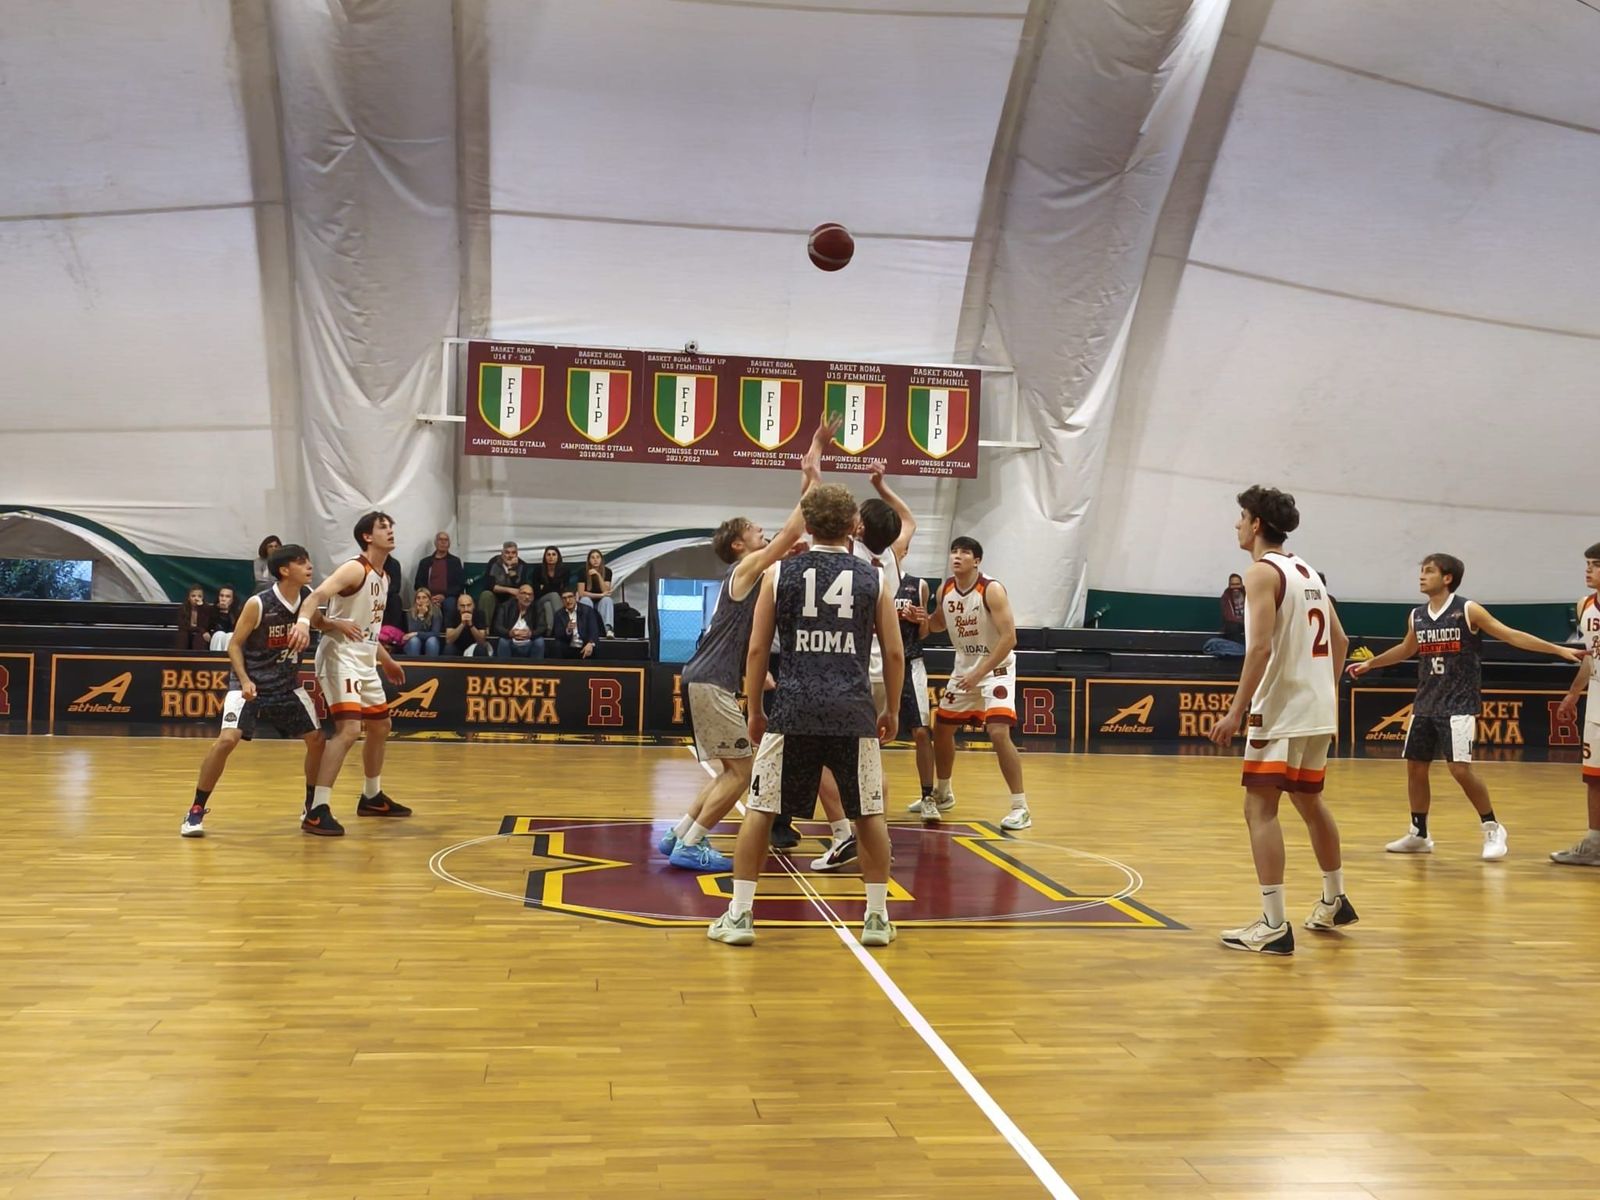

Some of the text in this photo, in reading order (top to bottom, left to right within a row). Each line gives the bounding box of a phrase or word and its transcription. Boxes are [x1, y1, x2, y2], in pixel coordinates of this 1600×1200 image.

[589, 359, 626, 367] FEMMINILE
[676, 363, 712, 372] FEMMINILE
[751, 360, 774, 368] BASKET
[830, 363, 881, 373] BASKET ROMA
[761, 367, 797, 376] FEMMINILE
[843, 373, 886, 382] FEMMINILE
[913, 368, 964, 378] BASKET ROMA
[927, 377, 969, 387] FEMMINILE
[506, 378, 516, 418] FIP
[594, 382, 604, 423] FIP
[680, 387, 690, 427] FIP
[766, 391, 775, 431] FIP
[850, 395, 859, 435] FIP
[934, 400, 943, 440] FIP
[472, 438, 546, 448] CAMPIONESSE D'ITALIA
[561, 442, 633, 452] CAMPIONESSE D'ITALIA
[647, 446, 719, 457] CAMPIONESSE D'ITALIA
[733, 450, 777, 459] CAMPIONESSE
[820, 454, 861, 463] AMPIONESSE
[901, 459, 971, 468] CAMPIONESSE D'ITALIA
[835, 462, 869, 470] 2022/202
[370, 582, 380, 596] 10
[802, 568, 854, 619] 14
[948, 600, 964, 613] 34
[955, 616, 977, 627] Basket
[269, 625, 285, 638] HSC
[1307, 607, 1329, 658] 2
[1427, 628, 1461, 642] PALOCCO
[795, 629, 857, 654] ROMA
[161, 669, 230, 690] BASK
[467, 676, 561, 697] BASKET
[161, 690, 225, 717] ROM
[1179, 692, 1236, 710] BASK
[67, 703, 131, 713] athletes
[389, 709, 439, 719] thletes
[465, 696, 560, 725] ROMA
[1481, 701, 1523, 719] KET
[1100, 724, 1154, 733] athletes
[1478, 719, 1525, 745] MA
[1365, 731, 1408, 740] athlet
[751, 775, 760, 796] 4
